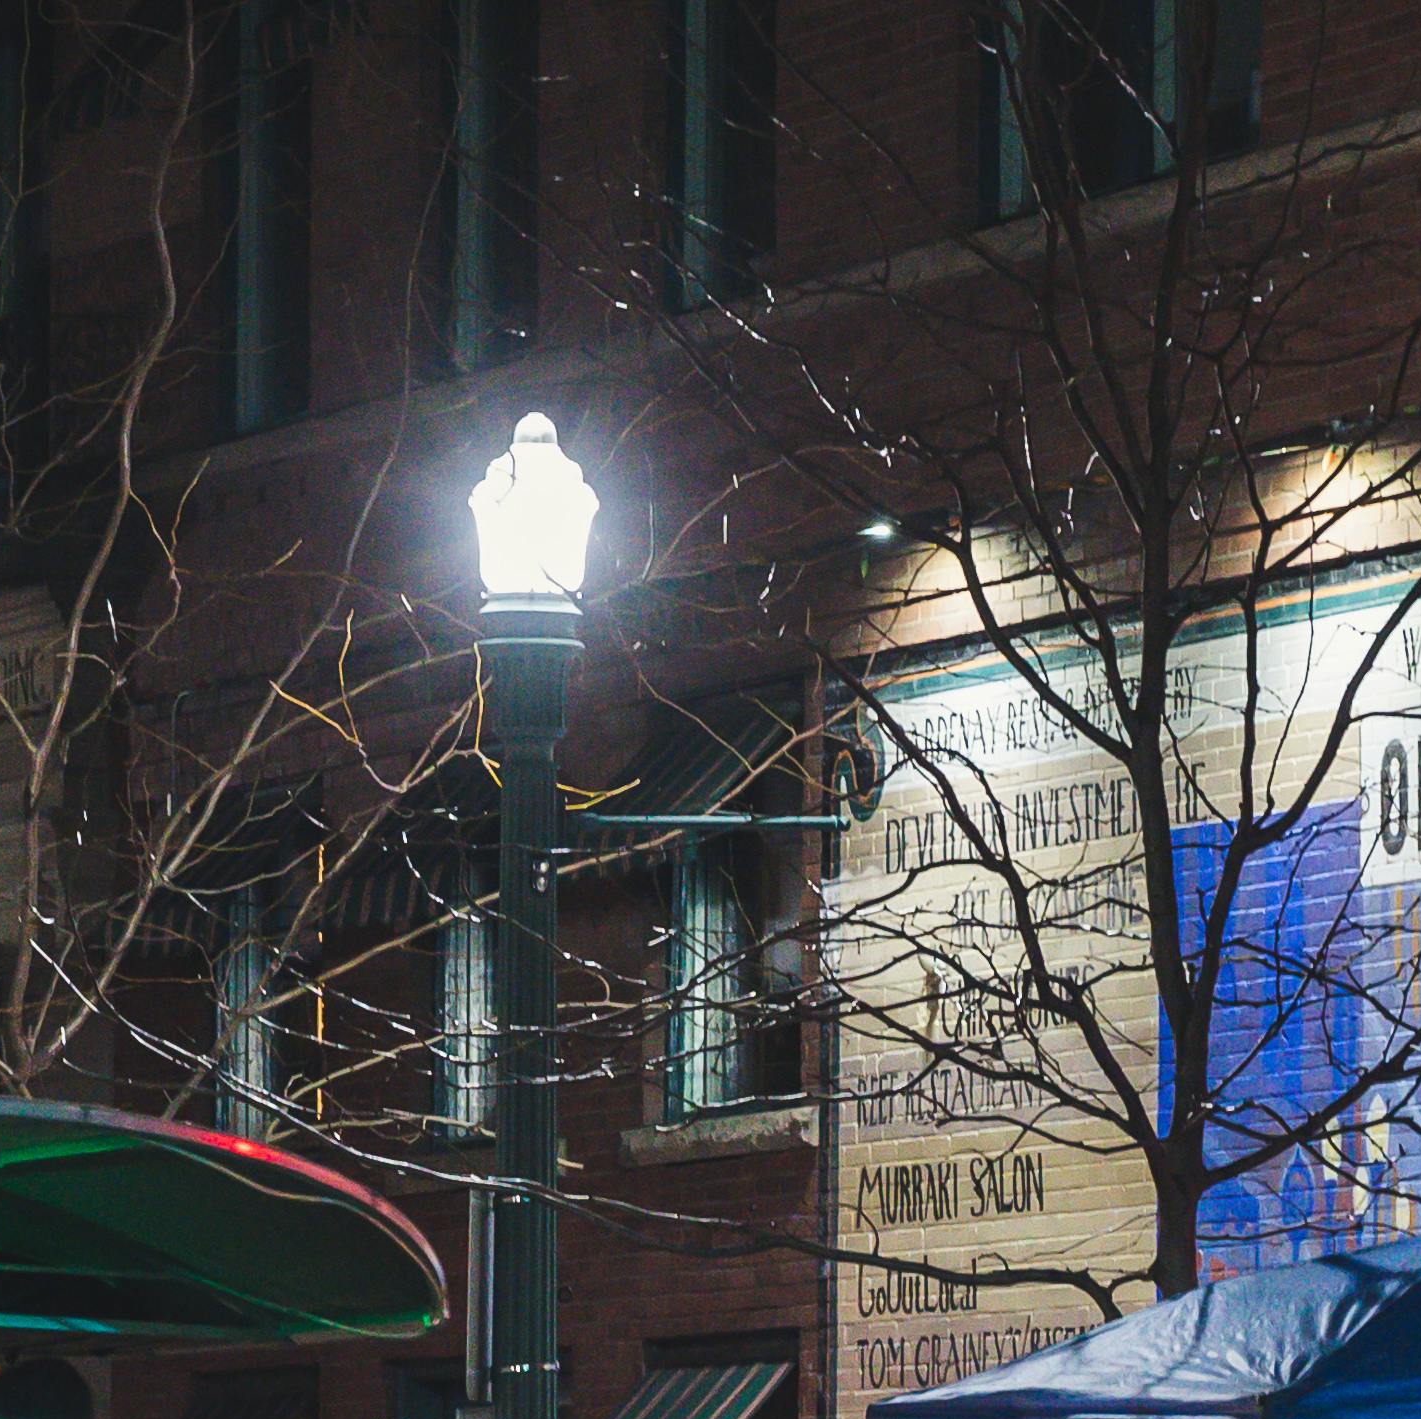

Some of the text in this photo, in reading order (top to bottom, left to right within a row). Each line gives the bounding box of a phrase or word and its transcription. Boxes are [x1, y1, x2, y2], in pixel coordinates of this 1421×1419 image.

[856, 1152, 1044, 1228] MURRAKI SALON
[857, 1336, 905, 1390] TOM
